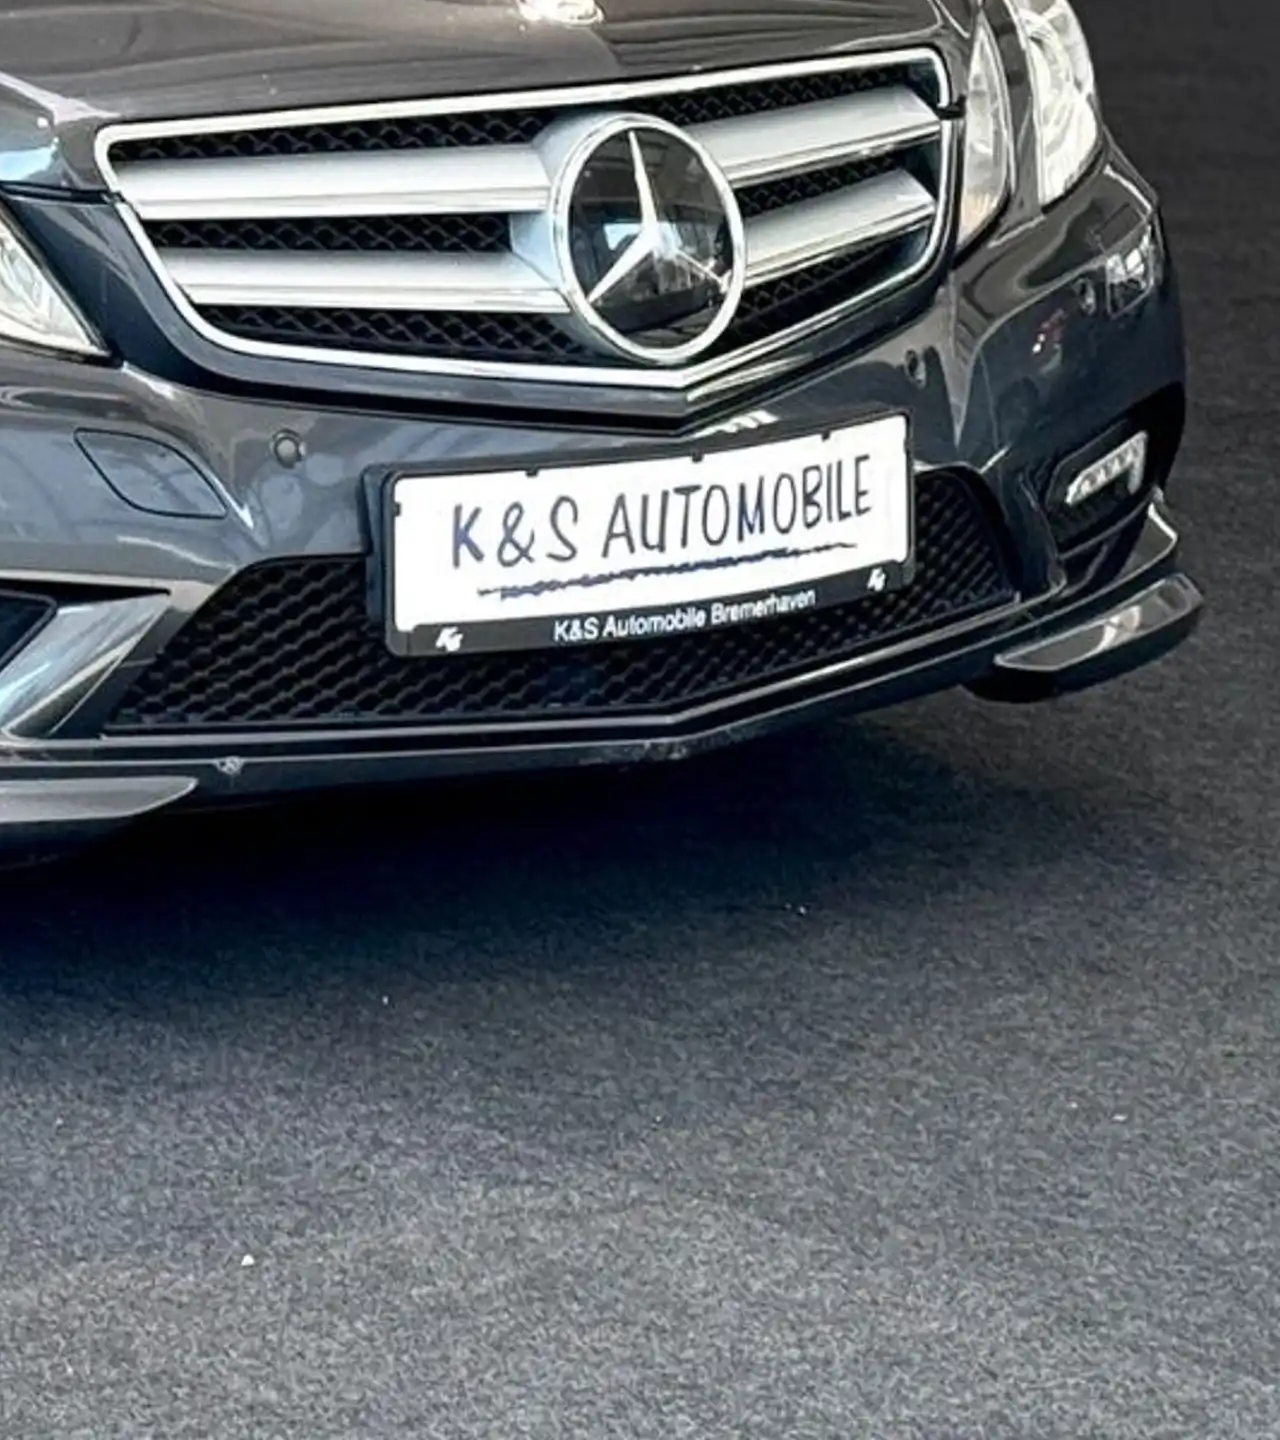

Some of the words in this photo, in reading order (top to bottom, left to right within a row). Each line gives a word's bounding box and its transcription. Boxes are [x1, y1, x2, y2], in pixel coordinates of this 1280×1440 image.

[600, 454, 872, 558] AUTOMOBILE
[553, 616, 600, 643] K&S
[602, 606, 707, 639] Automobile
[710, 588, 817, 626] Bremerhaven
